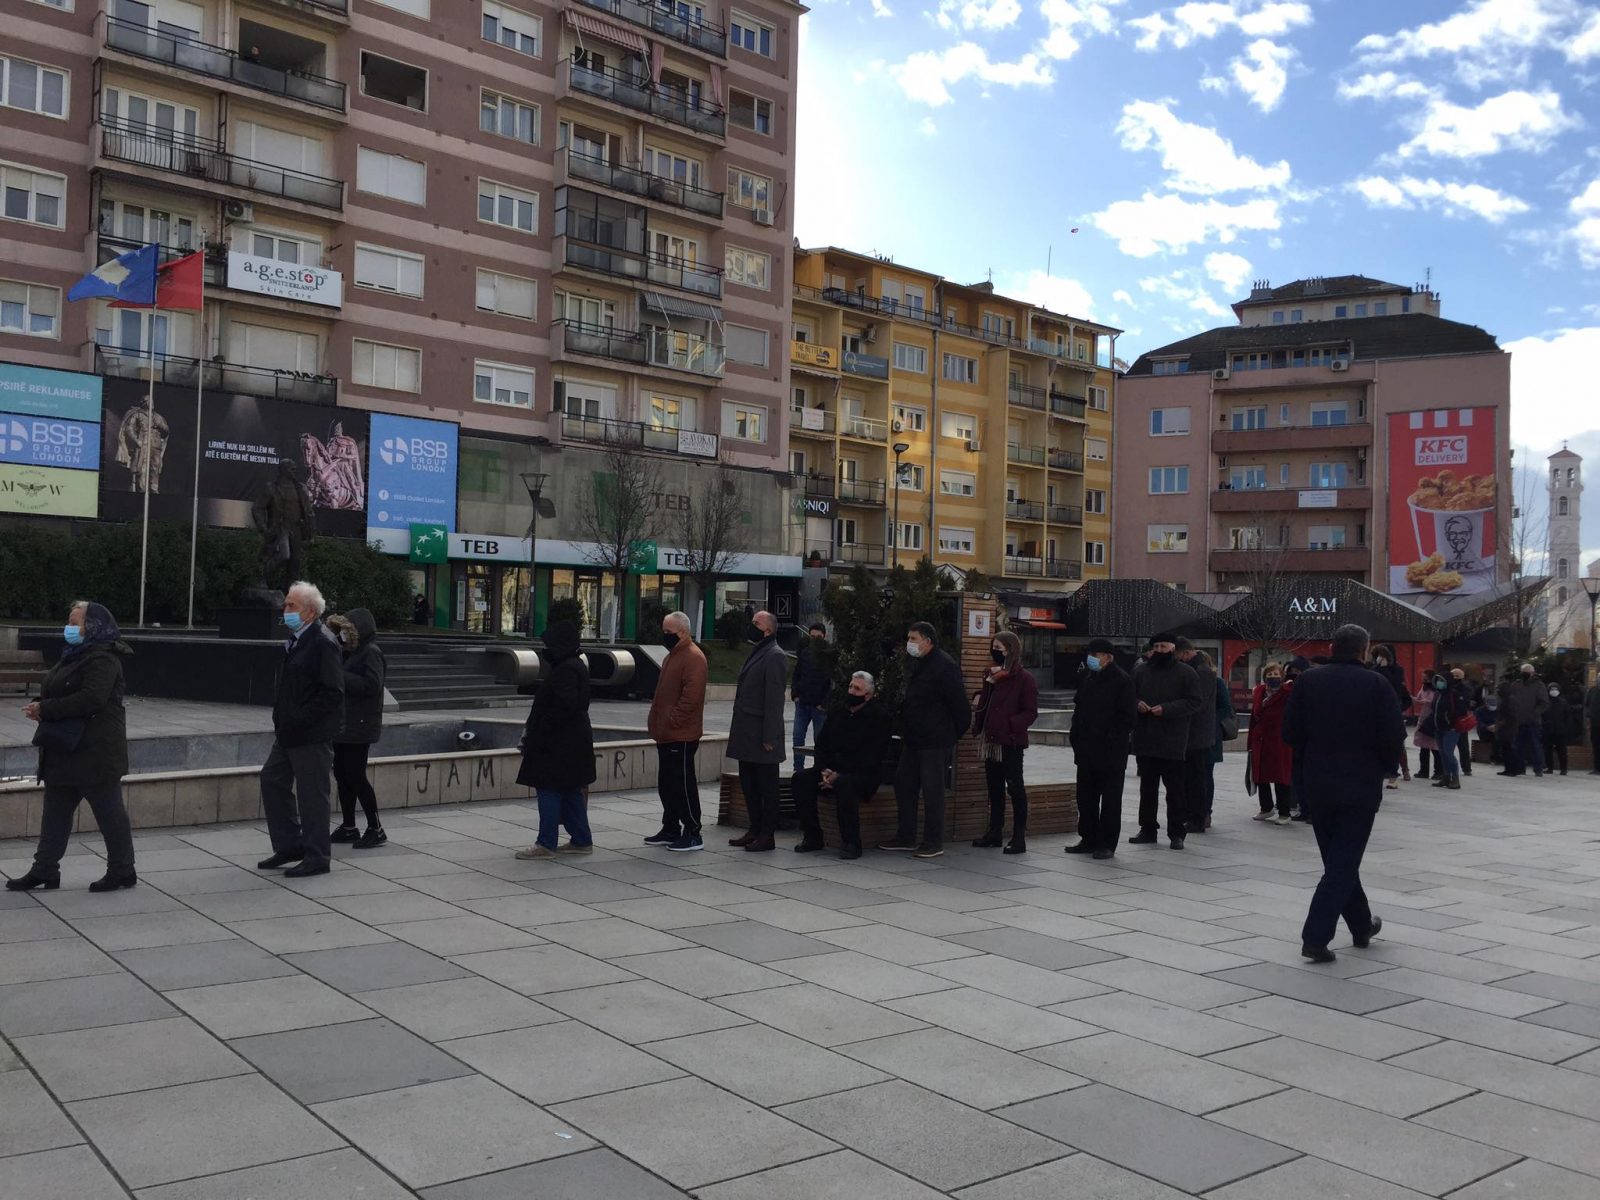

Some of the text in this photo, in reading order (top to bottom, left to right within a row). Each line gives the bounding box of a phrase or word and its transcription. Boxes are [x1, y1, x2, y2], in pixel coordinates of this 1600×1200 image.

[269, 279, 315, 291] SWITZERLAND
[29, 384, 92, 400] REKLAMUESE
[32, 422, 83, 447] BSB
[33, 444, 82, 454] GROUP
[411, 438, 447, 459] BSB
[1419, 438, 1465, 454] KFC
[33, 453, 80, 463] LONDON
[411, 456, 447, 466] GROUP
[1418, 453, 1465, 464] DELIVERY
[411, 464, 446, 473] LONDON
[50, 484, 64, 495] W
[651, 492, 691, 511] TEB
[461, 539, 499, 554] TEB
[664, 552, 695, 566] TEB
[1445, 560, 1475, 570] KFC
[1288, 596, 1337, 613] A&M
[414, 758, 495, 794] JAM
